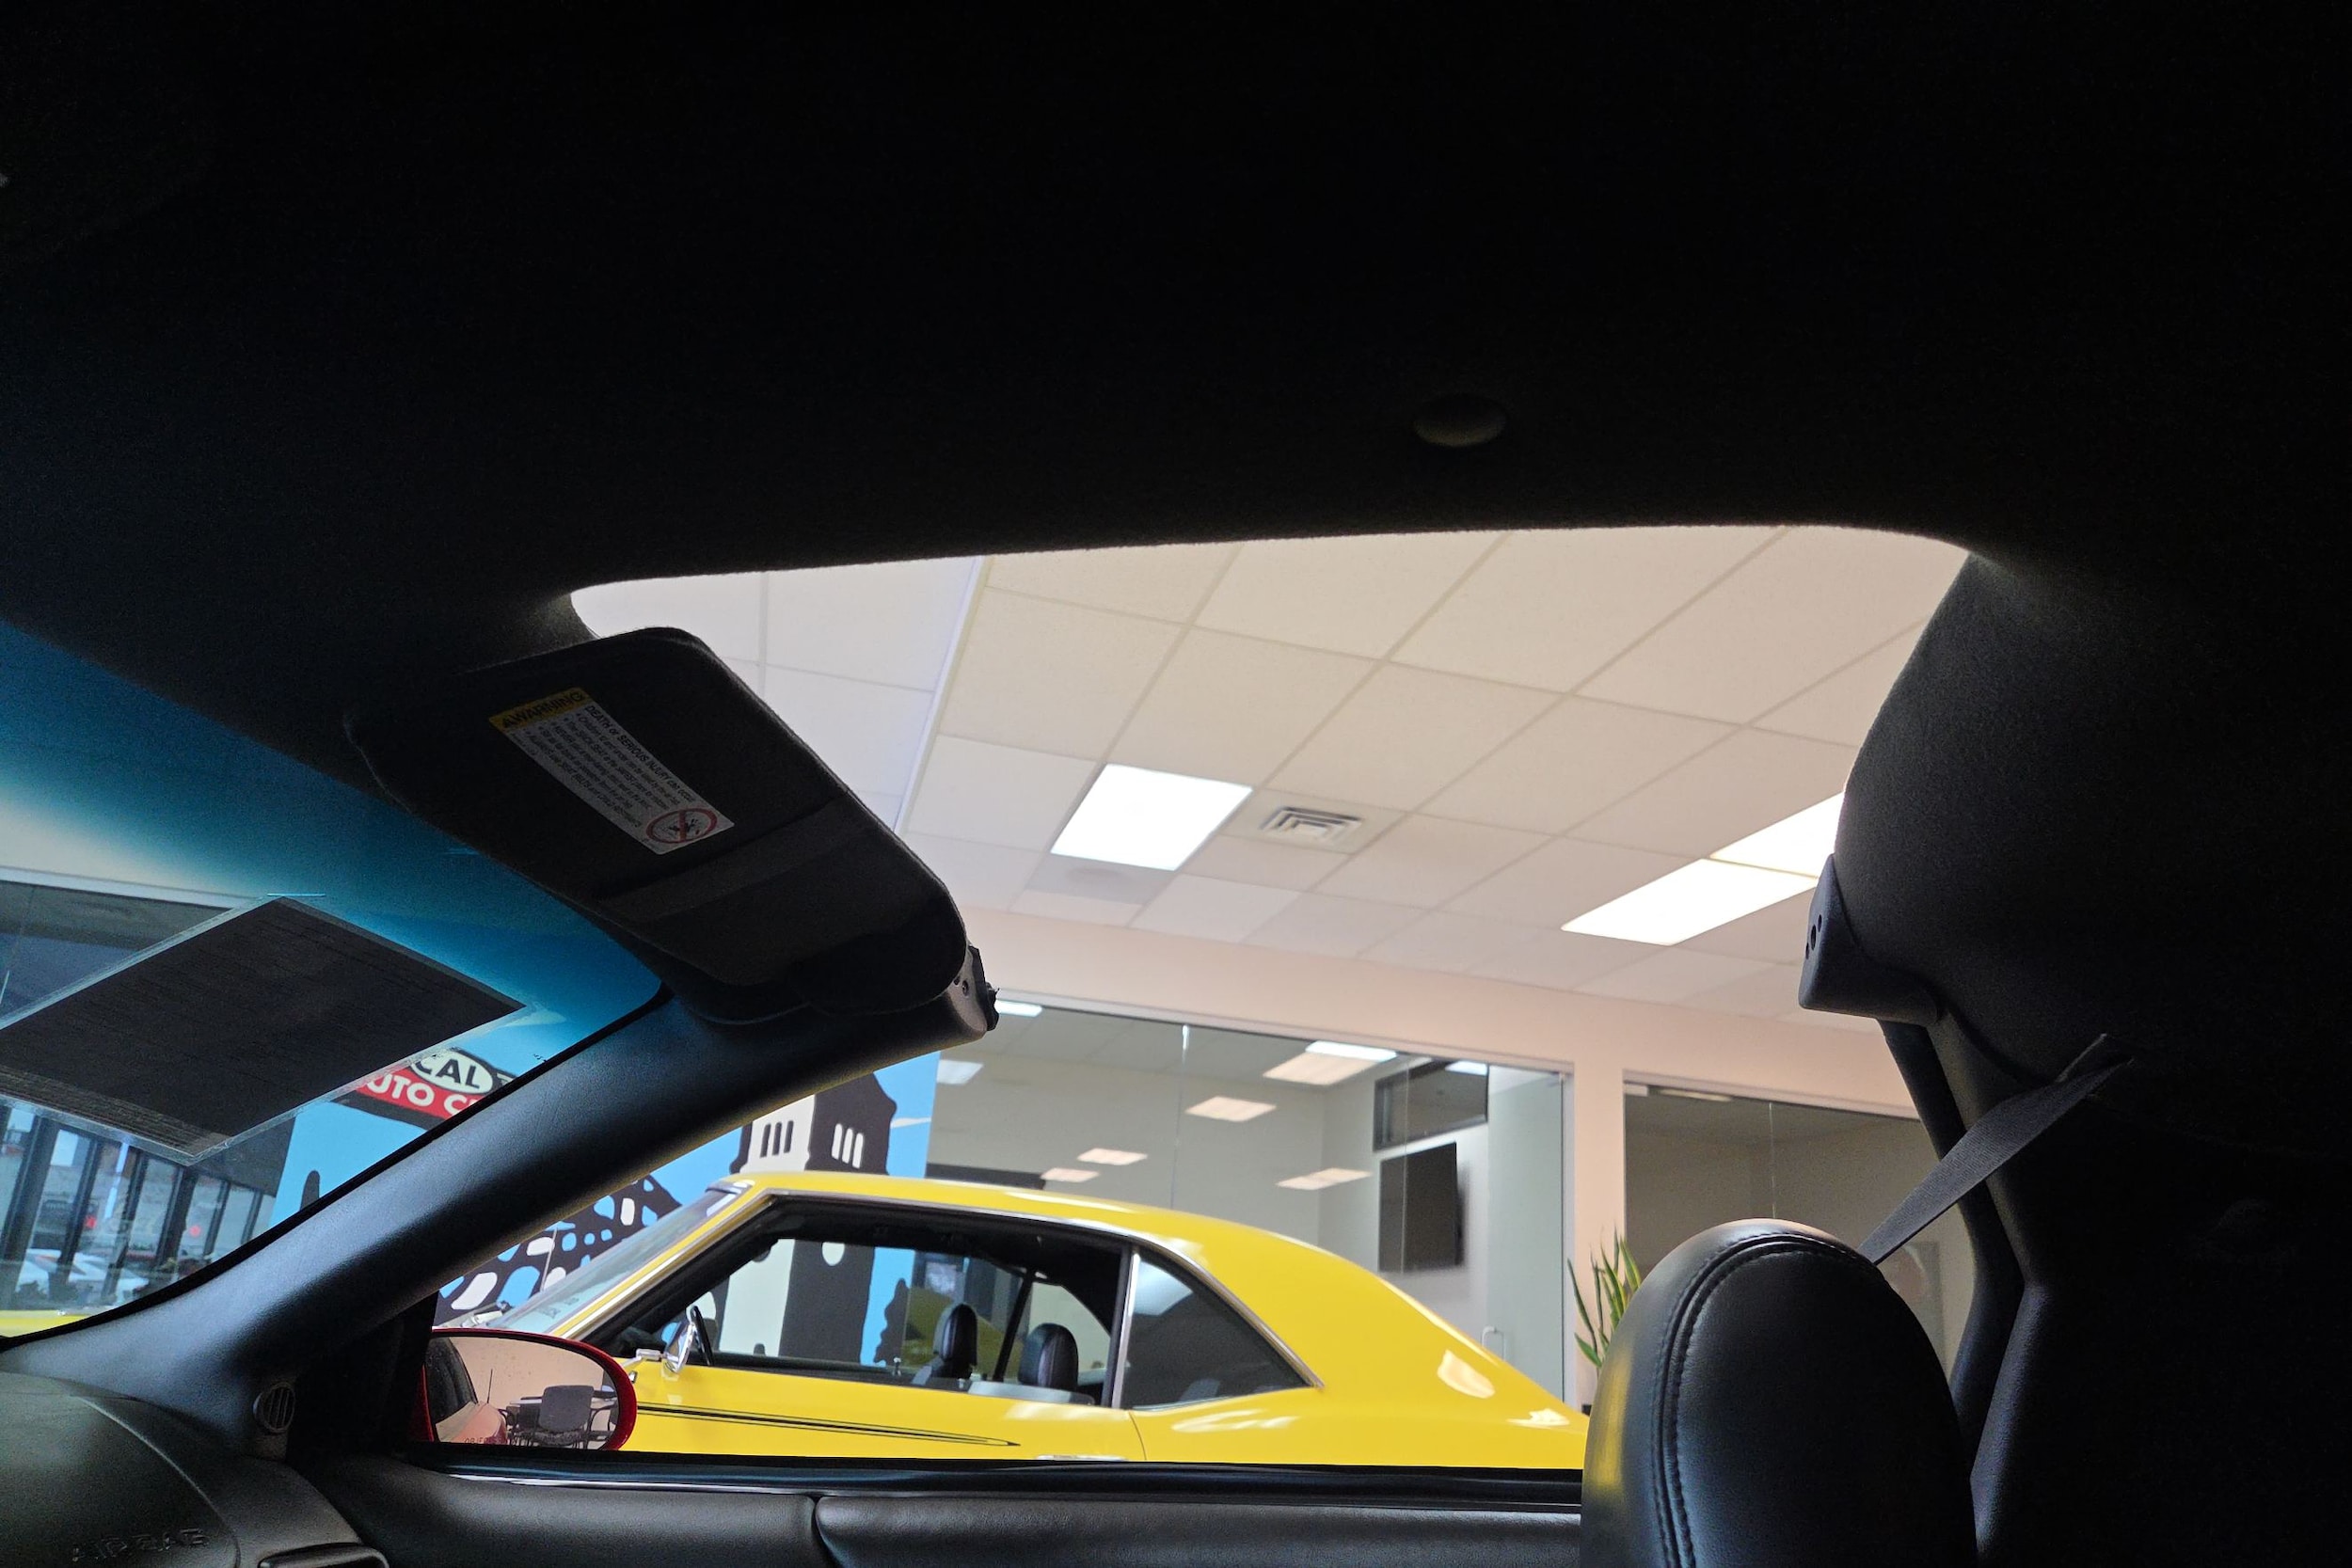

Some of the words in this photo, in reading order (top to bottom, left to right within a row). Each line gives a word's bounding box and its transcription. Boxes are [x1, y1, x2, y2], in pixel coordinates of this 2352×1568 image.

[509, 691, 583, 722] WARNING
[584, 705, 613, 728] DEATH
[616, 735, 650, 761] SERIOUS
[367, 1073, 435, 1106] UTO
